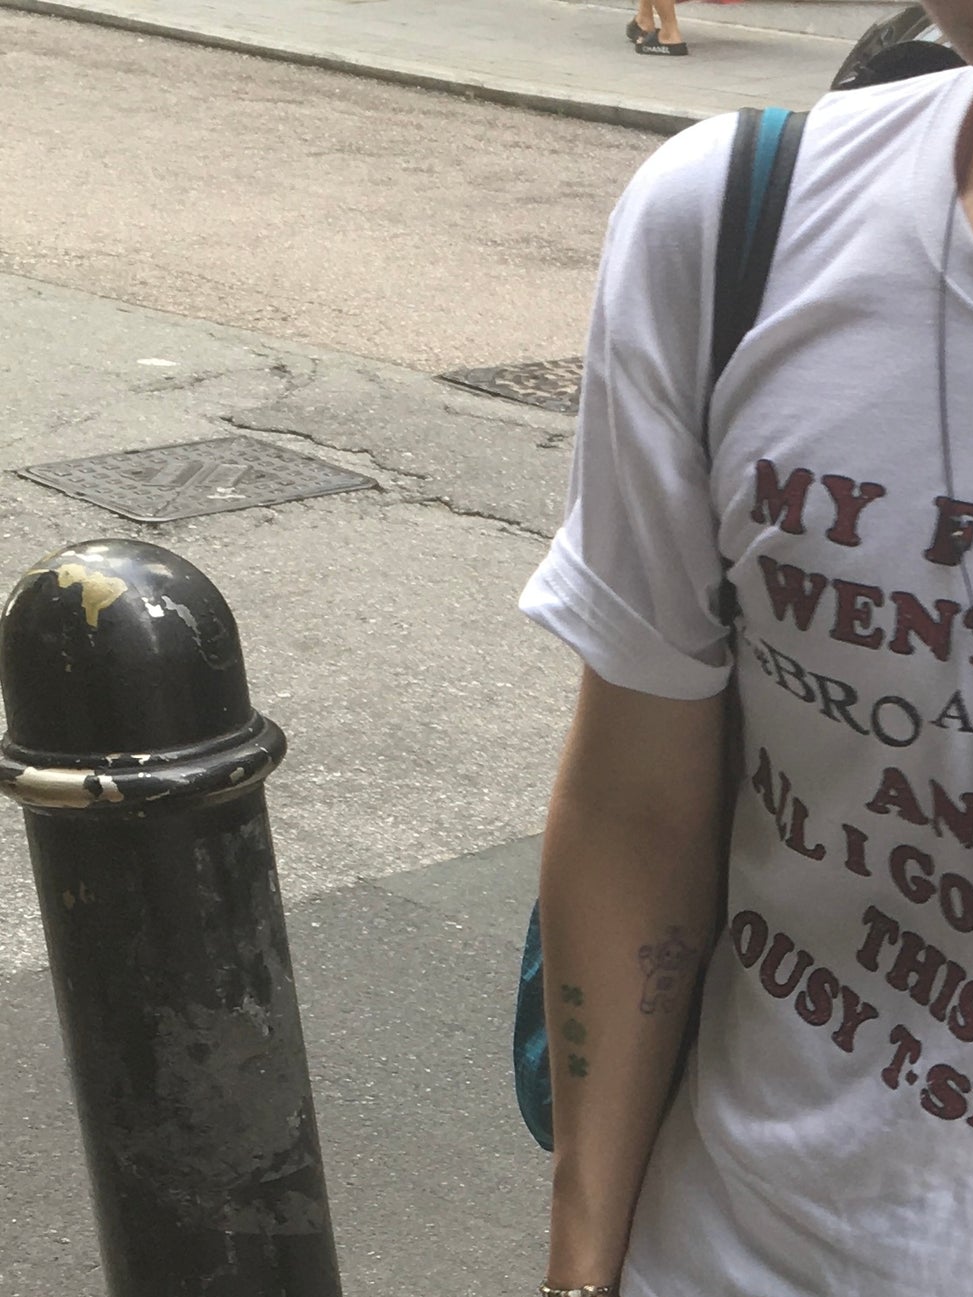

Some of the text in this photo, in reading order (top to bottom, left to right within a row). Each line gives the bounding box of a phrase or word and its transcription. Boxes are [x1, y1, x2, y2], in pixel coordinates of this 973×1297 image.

[751, 459, 887, 547] MY
[842, 823, 872, 877] I
[729, 910, 879, 1053] OUSY
